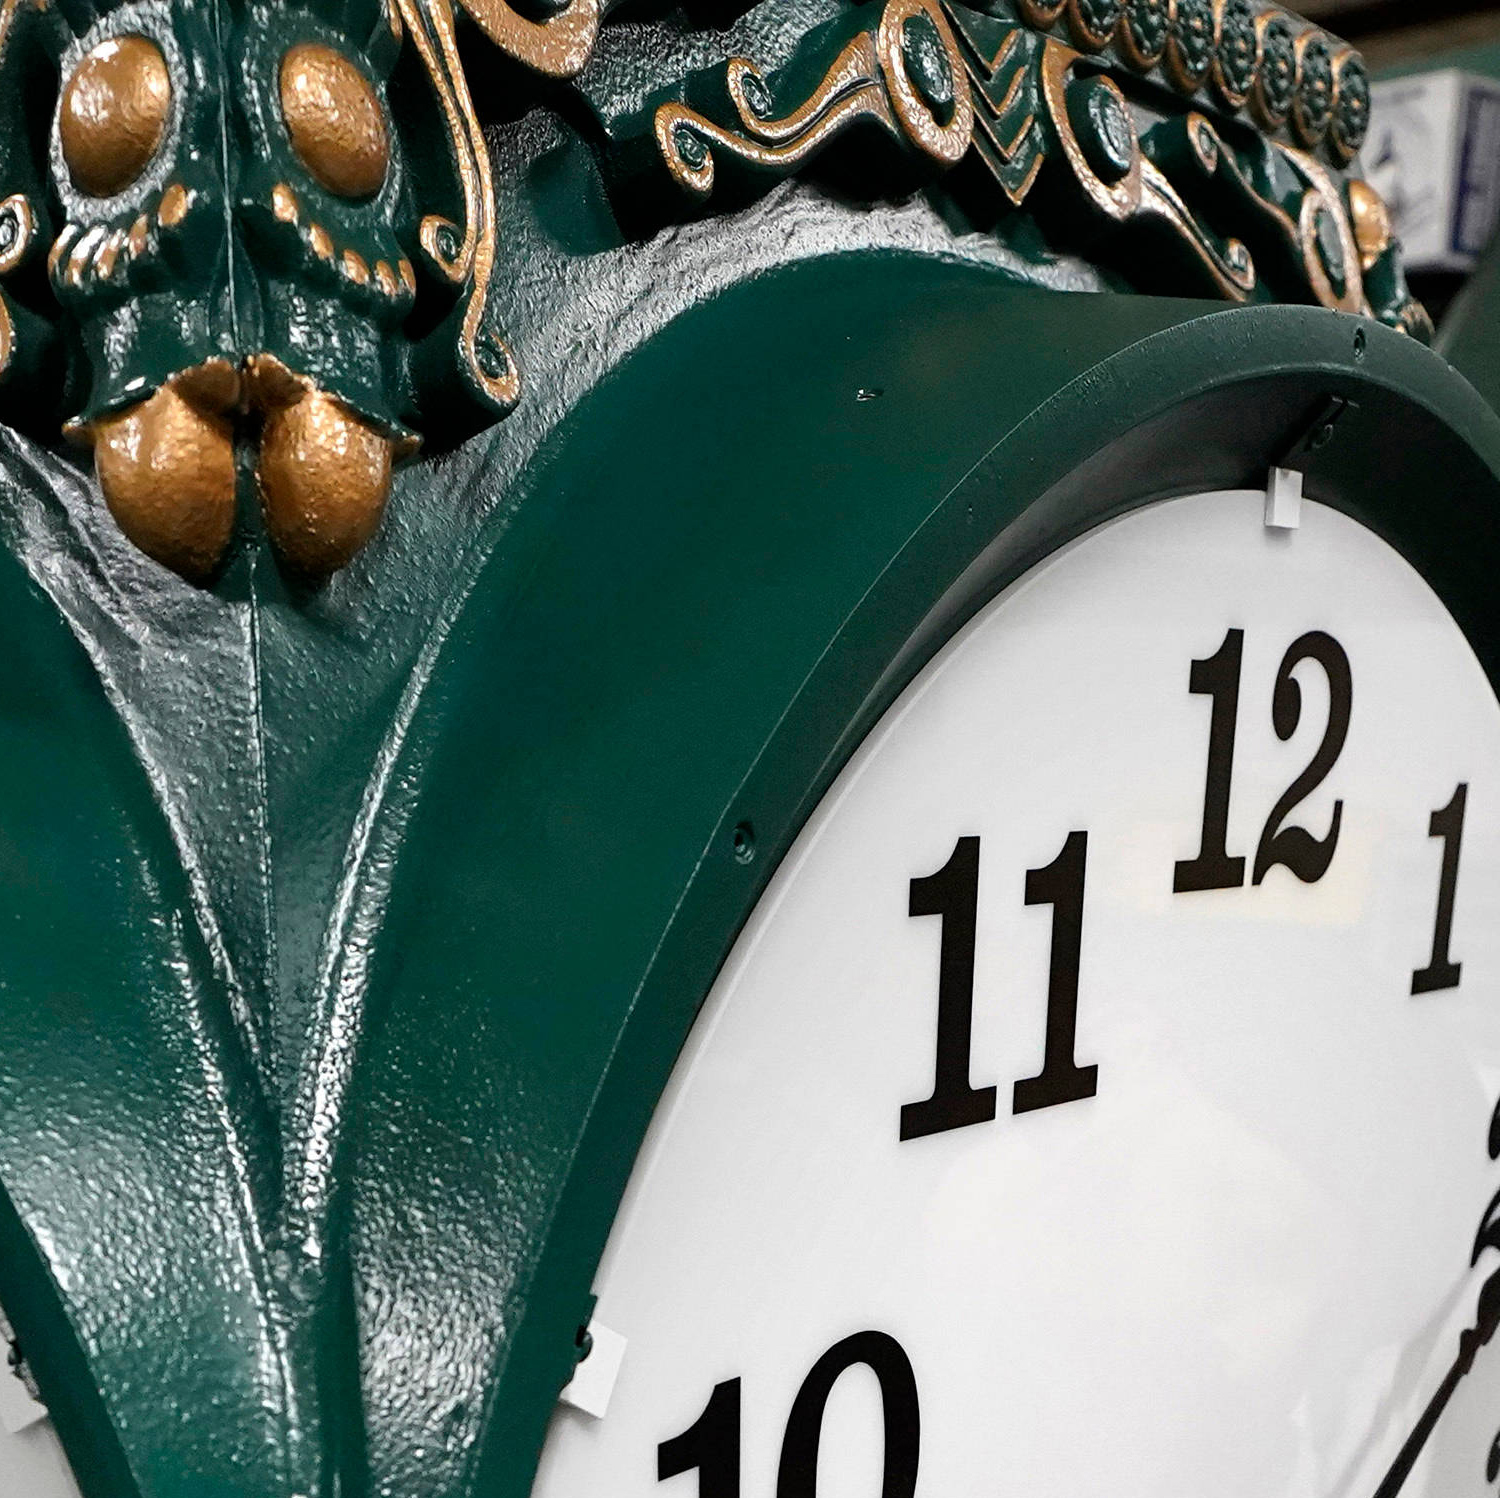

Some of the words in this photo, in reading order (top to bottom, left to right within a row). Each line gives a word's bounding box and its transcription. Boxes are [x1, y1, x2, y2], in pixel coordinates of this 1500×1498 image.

[1172, 627, 1353, 894] 12
[1410, 783, 1468, 996] 1
[899, 830, 1099, 1143] 11
